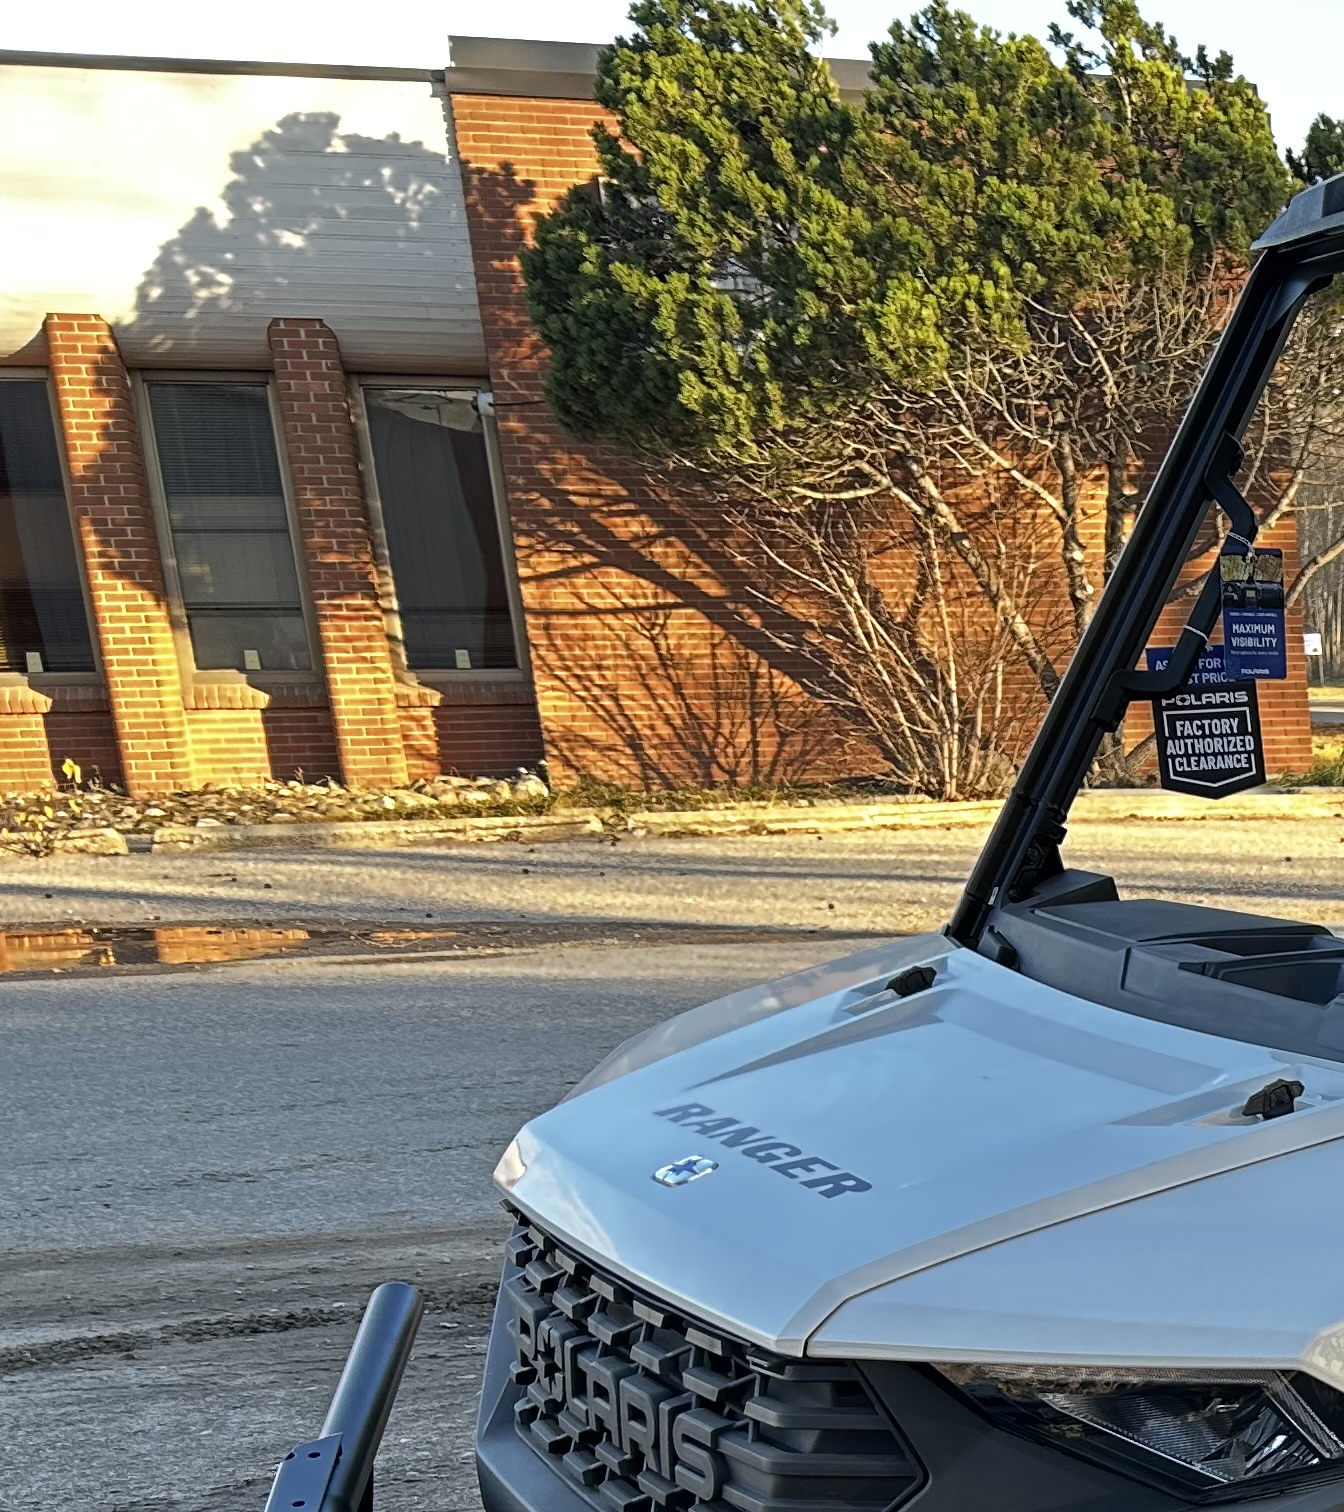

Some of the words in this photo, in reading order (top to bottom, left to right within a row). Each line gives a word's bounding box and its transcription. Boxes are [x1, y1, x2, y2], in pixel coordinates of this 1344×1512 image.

[1232, 623, 1276, 635] MAXIMUM
[1231, 637, 1278, 648] VISIBILITY
[1198, 658, 1222, 670] FOR
[1202, 673, 1236, 684] PRIC
[1175, 717, 1239, 737] FACTORY
[1166, 735, 1255, 756] AUTHORIZED
[1174, 753, 1250, 772] CLEARANCE
[653, 1102, 873, 1199] RANGER
[506, 1280, 722, 1502] POLARIS
